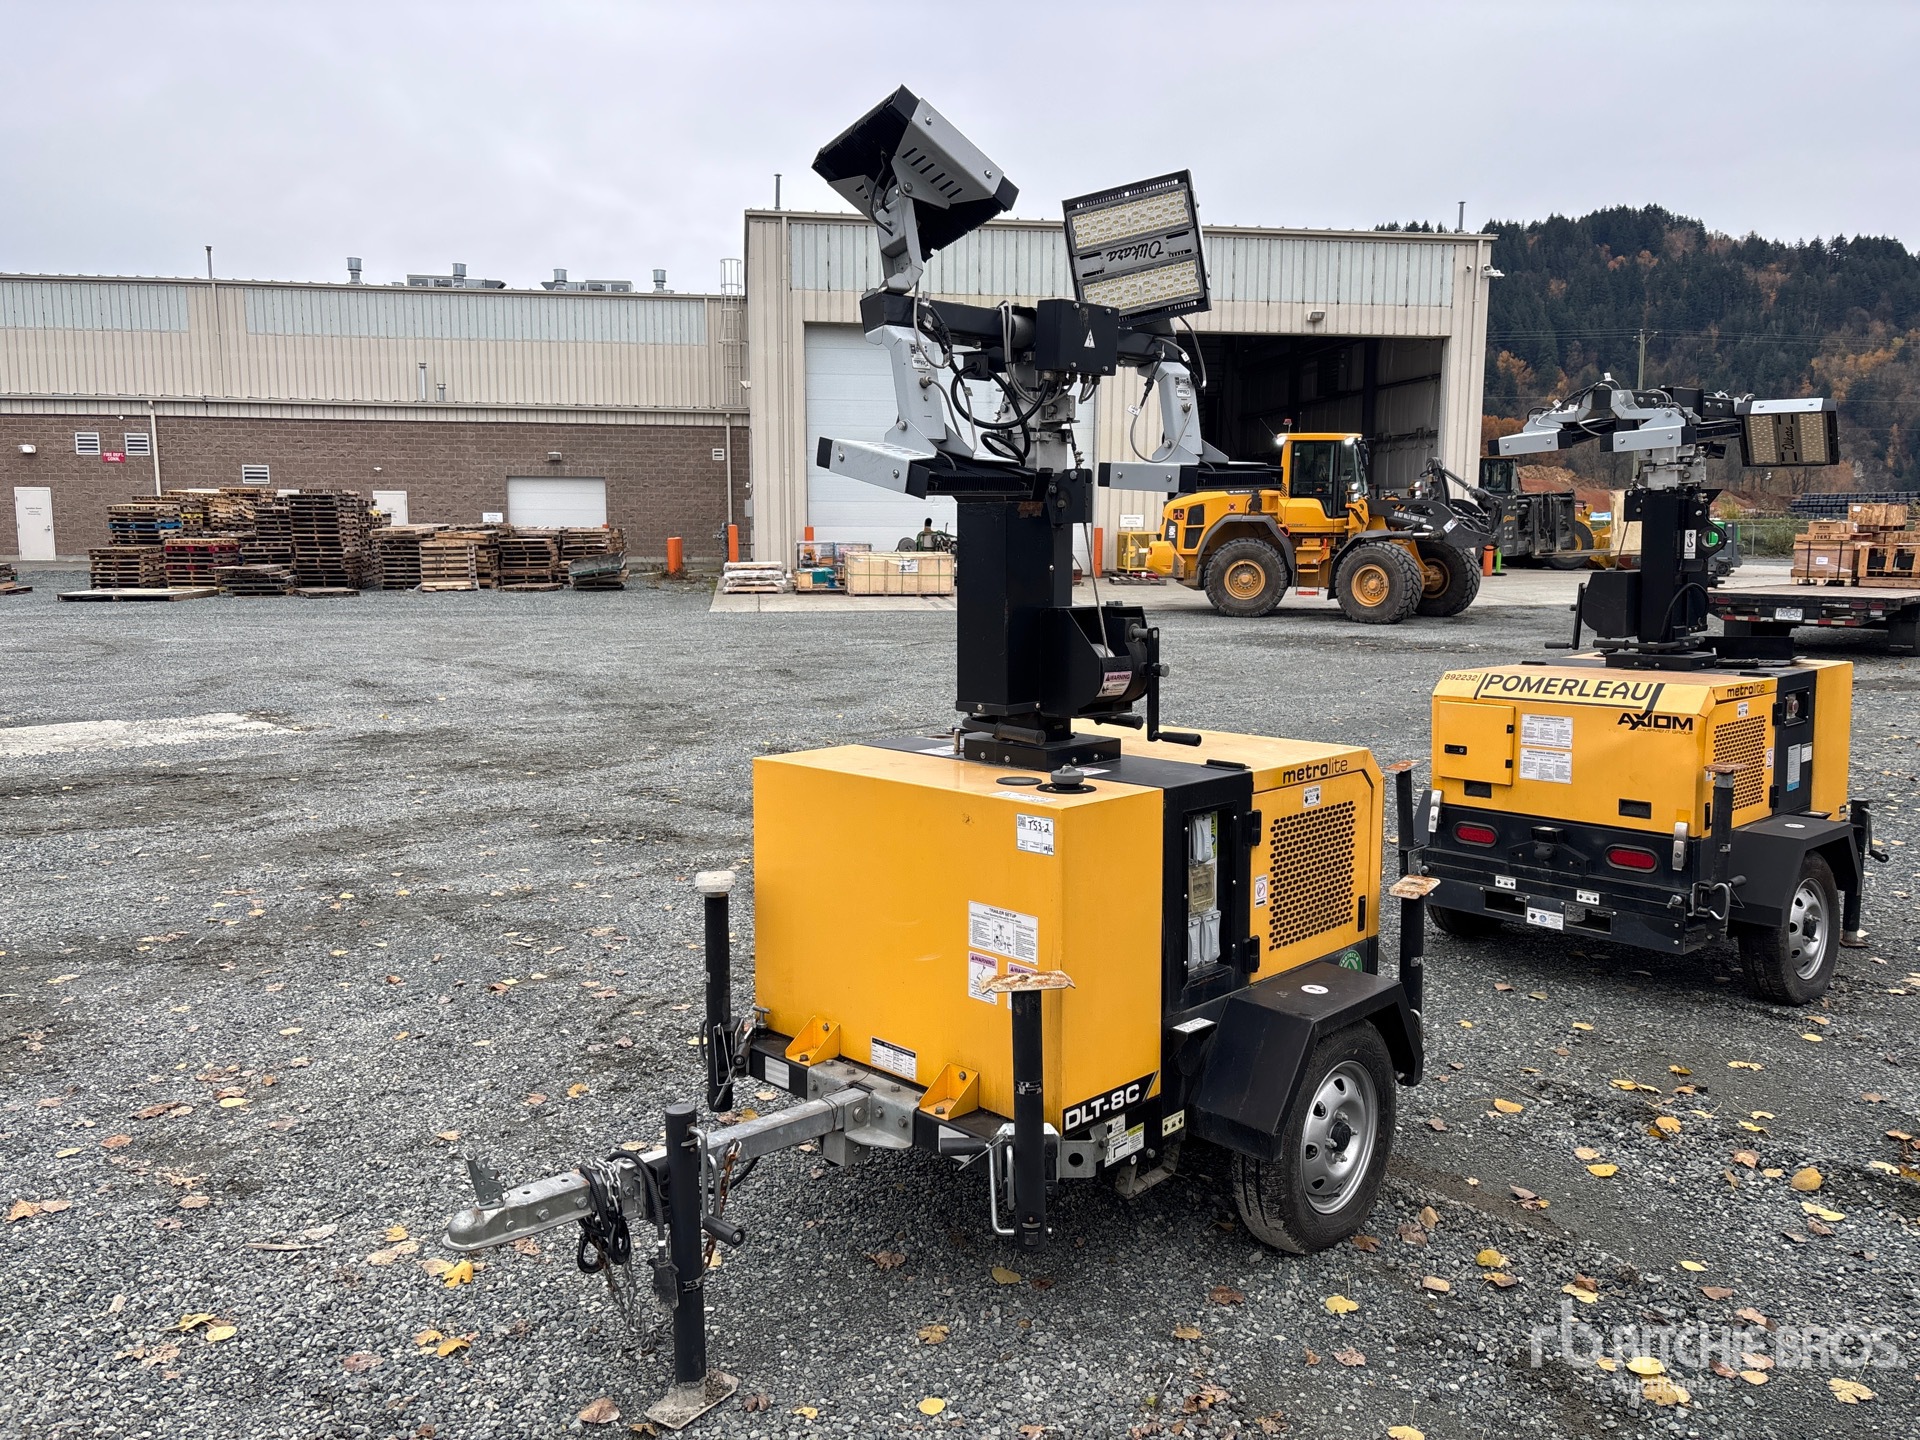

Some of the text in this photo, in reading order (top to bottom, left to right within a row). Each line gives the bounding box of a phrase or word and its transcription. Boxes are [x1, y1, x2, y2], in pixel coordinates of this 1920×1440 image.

[1106, 240, 1164, 262] Olikara
[1444, 673, 1654, 701] 892232 POMERLEAU
[1726, 682, 1765, 698] metrolite
[1617, 711, 1694, 731] AXIOM
[1282, 757, 1348, 784] metrolite
[974, 955, 996, 967] WARNING
[1065, 1083, 1139, 1131] DLT-8C
